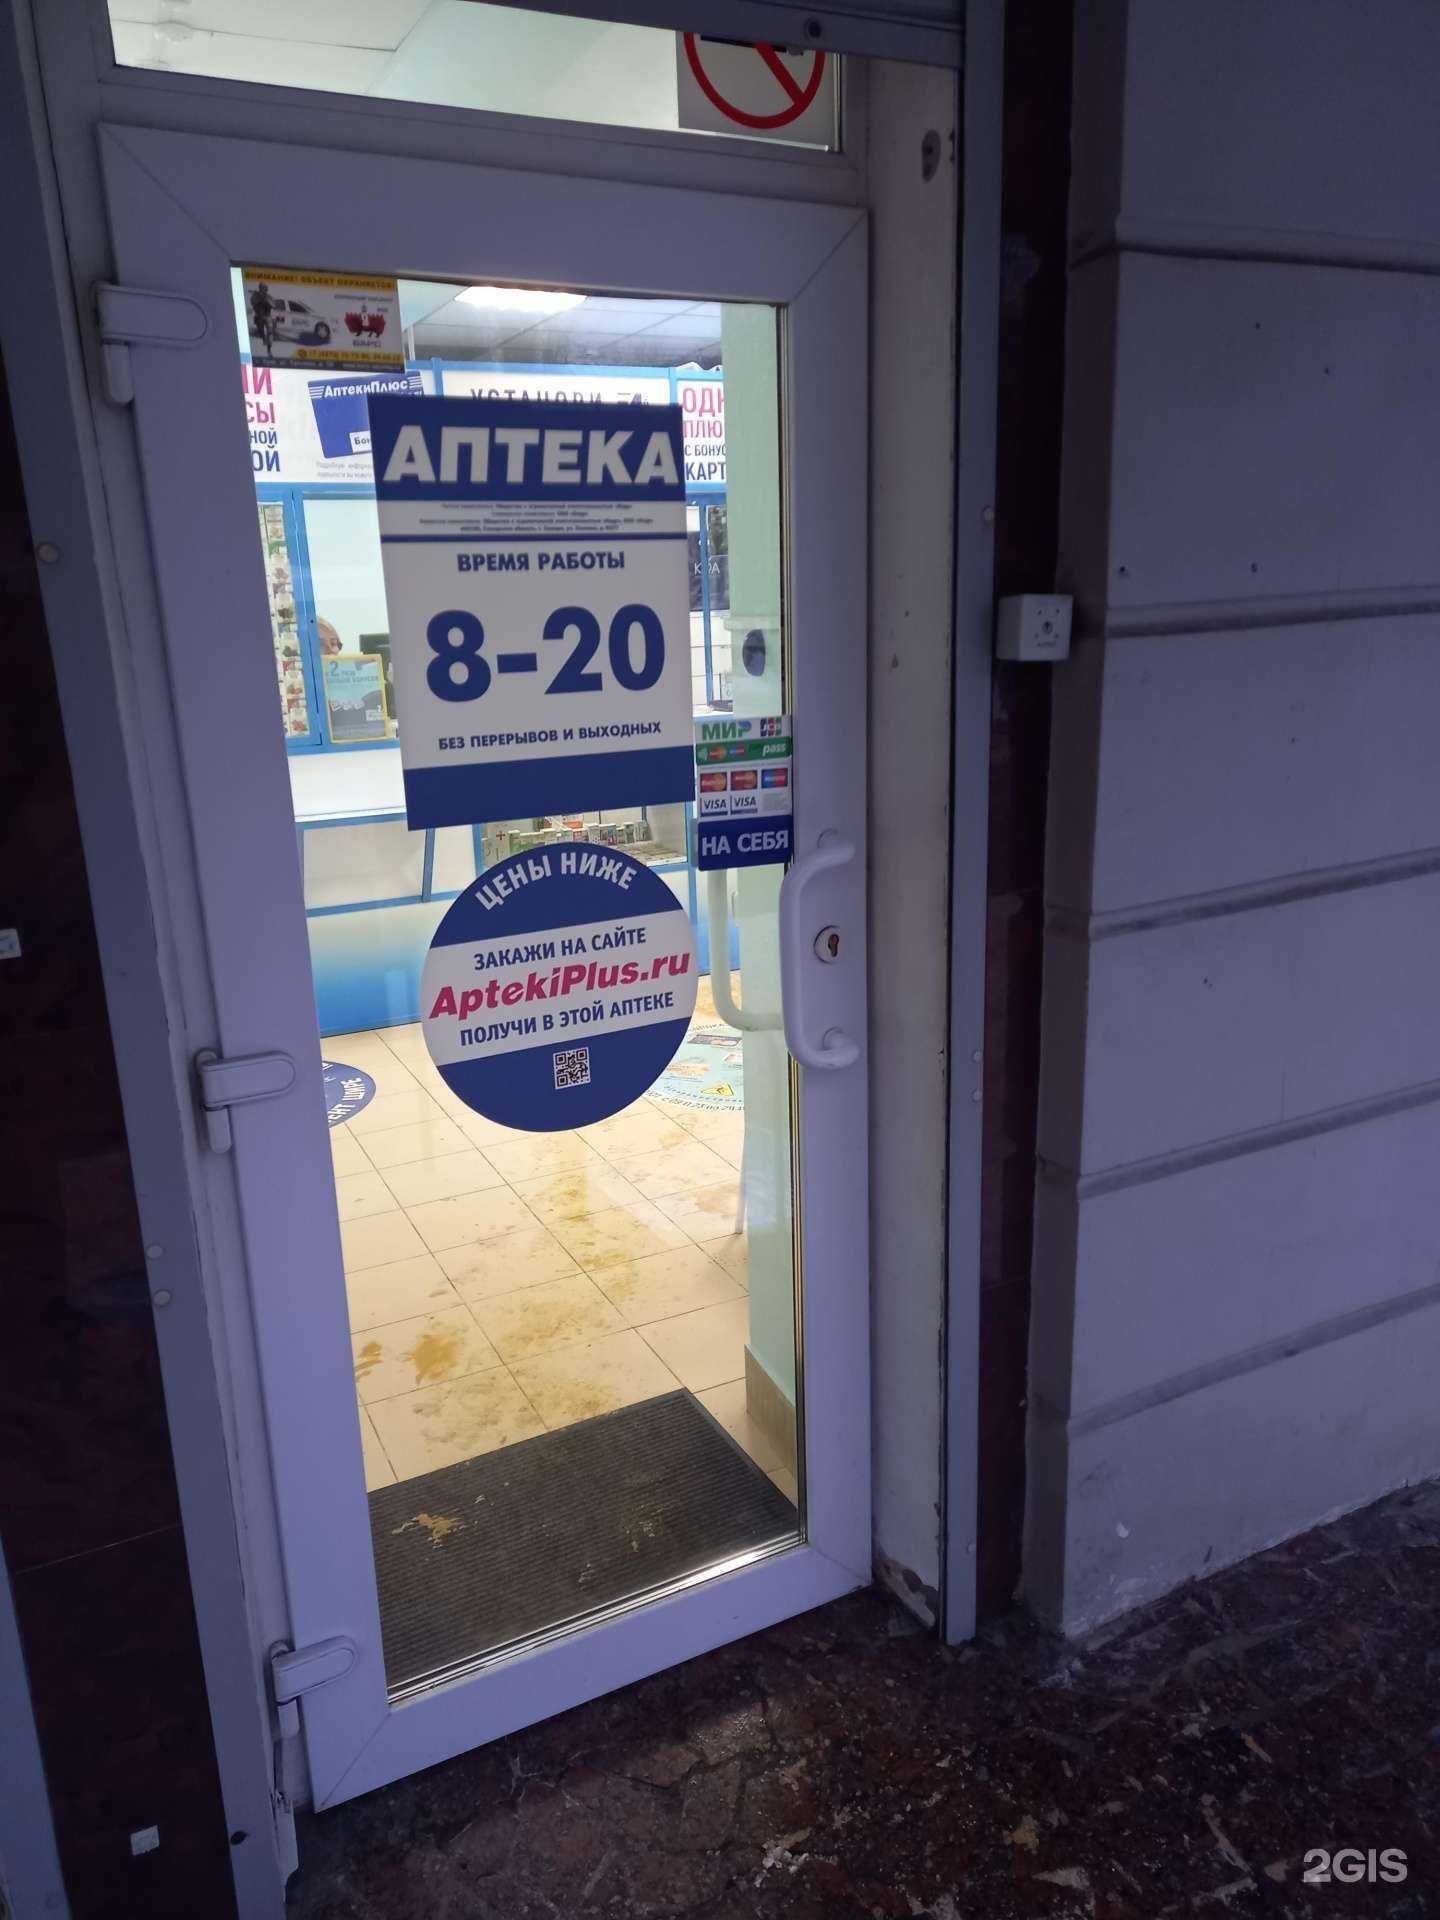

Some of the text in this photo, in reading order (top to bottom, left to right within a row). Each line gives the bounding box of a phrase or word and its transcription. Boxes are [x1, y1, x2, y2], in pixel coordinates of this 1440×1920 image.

[383, 425, 679, 485] АПТЕКА
[457, 552, 625, 571] ВРЕМЯ РАБОТЫ
[438, 721, 662, 751] БЕЗ ПЕРЕРЫВОВ И ВЫХОДНЫХ
[702, 721, 752, 740] МИР
[704, 798, 727, 810] VISA
[734, 795, 757, 808] VISA
[702, 830, 789, 857] НА СЕБЯ
[474, 851, 638, 913] ЦЕНЫ НИЖЕ
[474, 926, 647, 970] ЗАКАЖИ НА САЙТЕ
[429, 950, 691, 1021] AptekiPlus.ru
[460, 991, 675, 1047] ПОЛУЧИ В ЭТОЙ АПТЕКЕ
